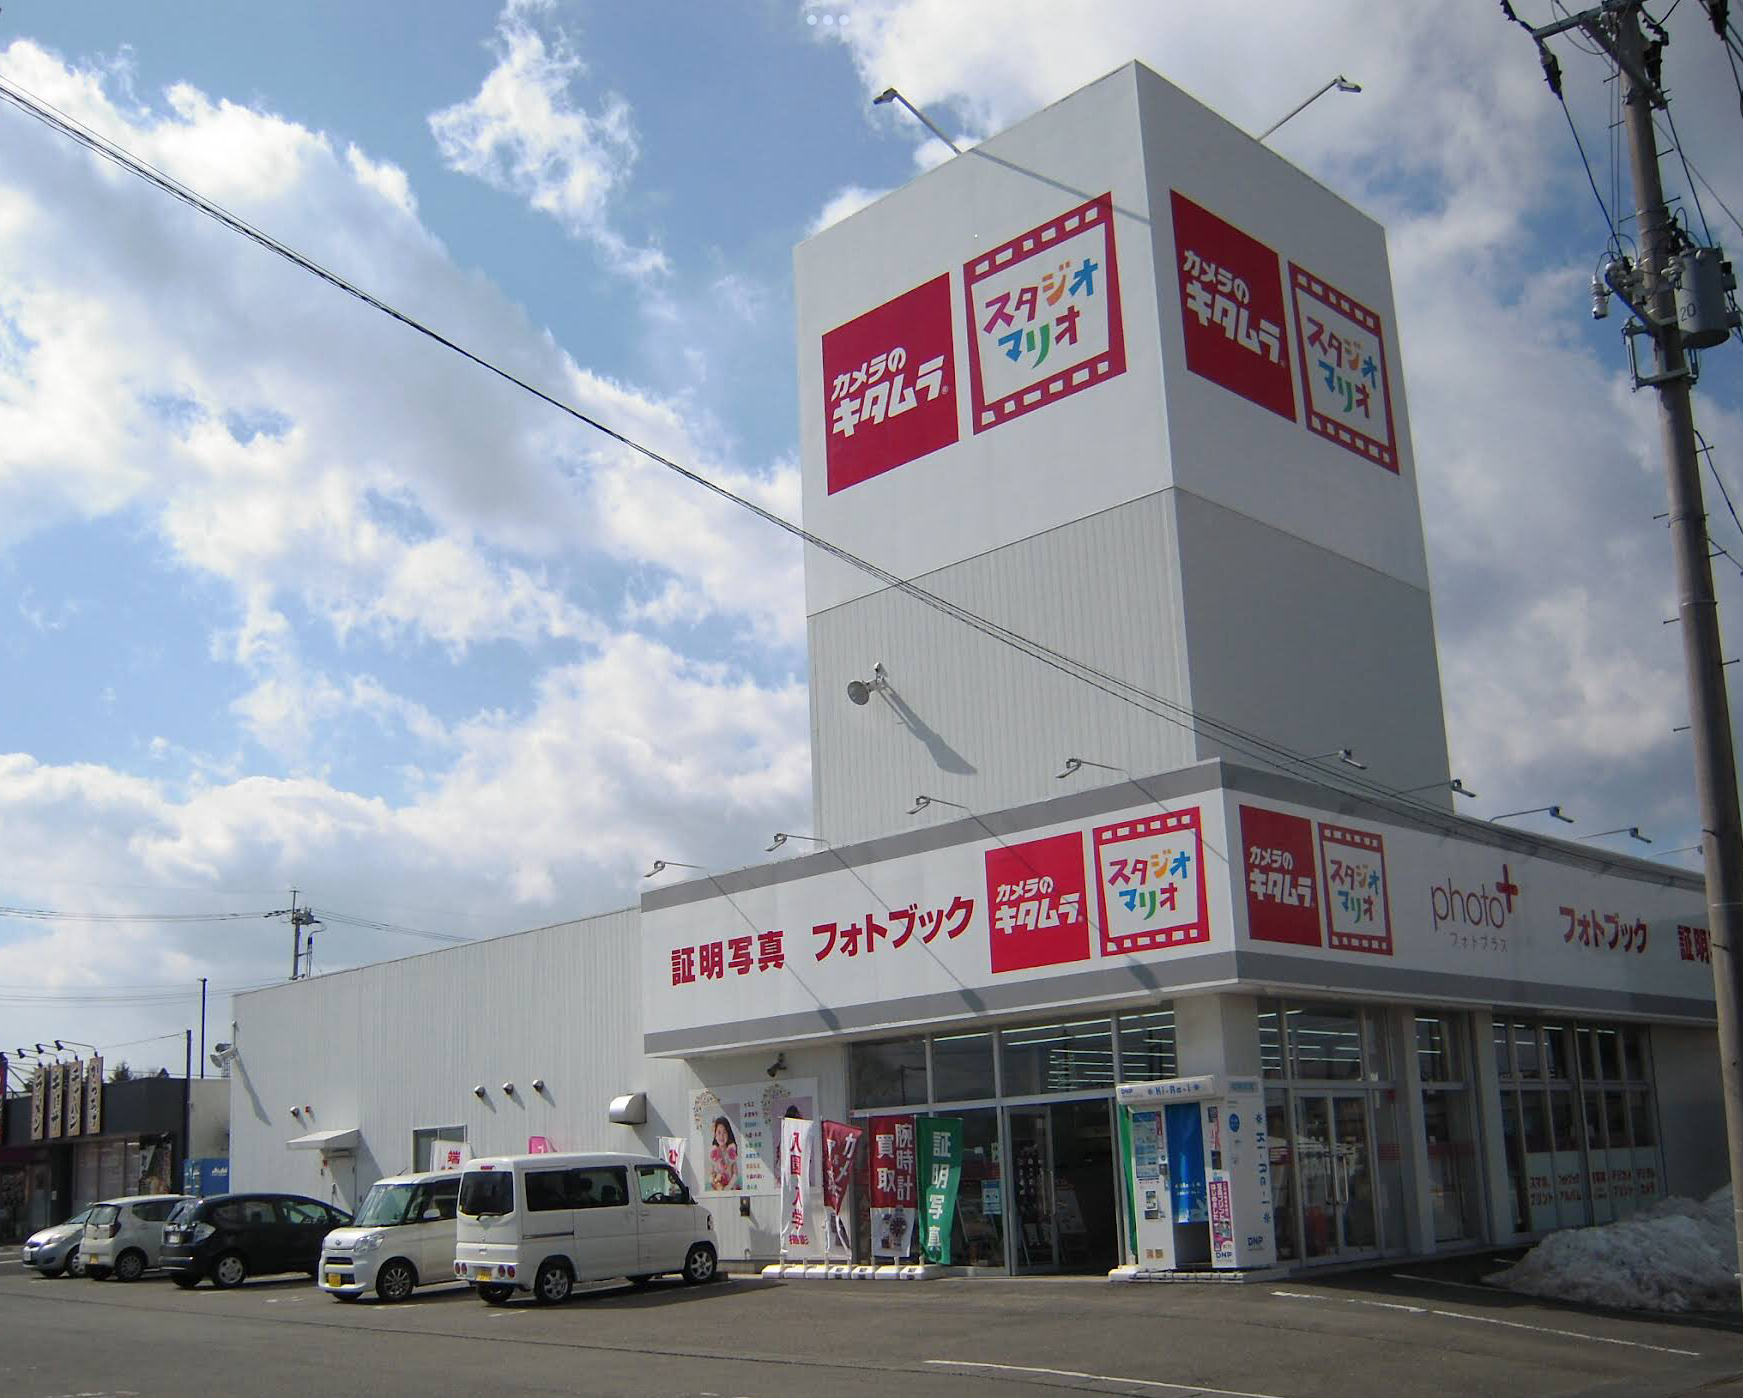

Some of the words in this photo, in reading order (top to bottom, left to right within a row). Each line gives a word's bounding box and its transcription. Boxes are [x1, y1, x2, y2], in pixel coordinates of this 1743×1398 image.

[983, 258, 1098, 334] スタジオ
[1184, 248, 1251, 305] カメラの
[997, 305, 1081, 368] マリオ
[1185, 282, 1281, 369] キタムラ
[1680, 302, 1697, 322] 20
[831, 346, 907, 397] カメラの
[1306, 315, 1378, 390] スタジオ
[831, 354, 946, 438] キタムラ
[1317, 359, 1371, 420] マリオ
[1108, 849, 1191, 885] スタジオ
[1249, 845, 1293, 871] カメラの
[1329, 858, 1380, 894] スタジオ
[994, 891, 1081, 935] キタムラ
[995, 875, 1054, 901] カメラの
[1118, 883, 1179, 921] マリオ
[1249, 868, 1315, 909] キタムラ
[1336, 889, 1375, 924] マリオ
[812, 896, 975, 962] フォトブック
[1450, 932, 1509, 953] フォトプラス
[1559, 905, 1648, 955] フォトブック
[1677, 924, 1712, 964] 証明
[670, 929, 785, 986] 証明写真
[875, 1134, 896, 1193] 買取
[894, 1123, 914, 1202] 腕時計
[927, 1131, 951, 1249] 証明写真
[1215, 1251, 1232, 1259] DNP
[1247, 1236, 1264, 1246] DNP
